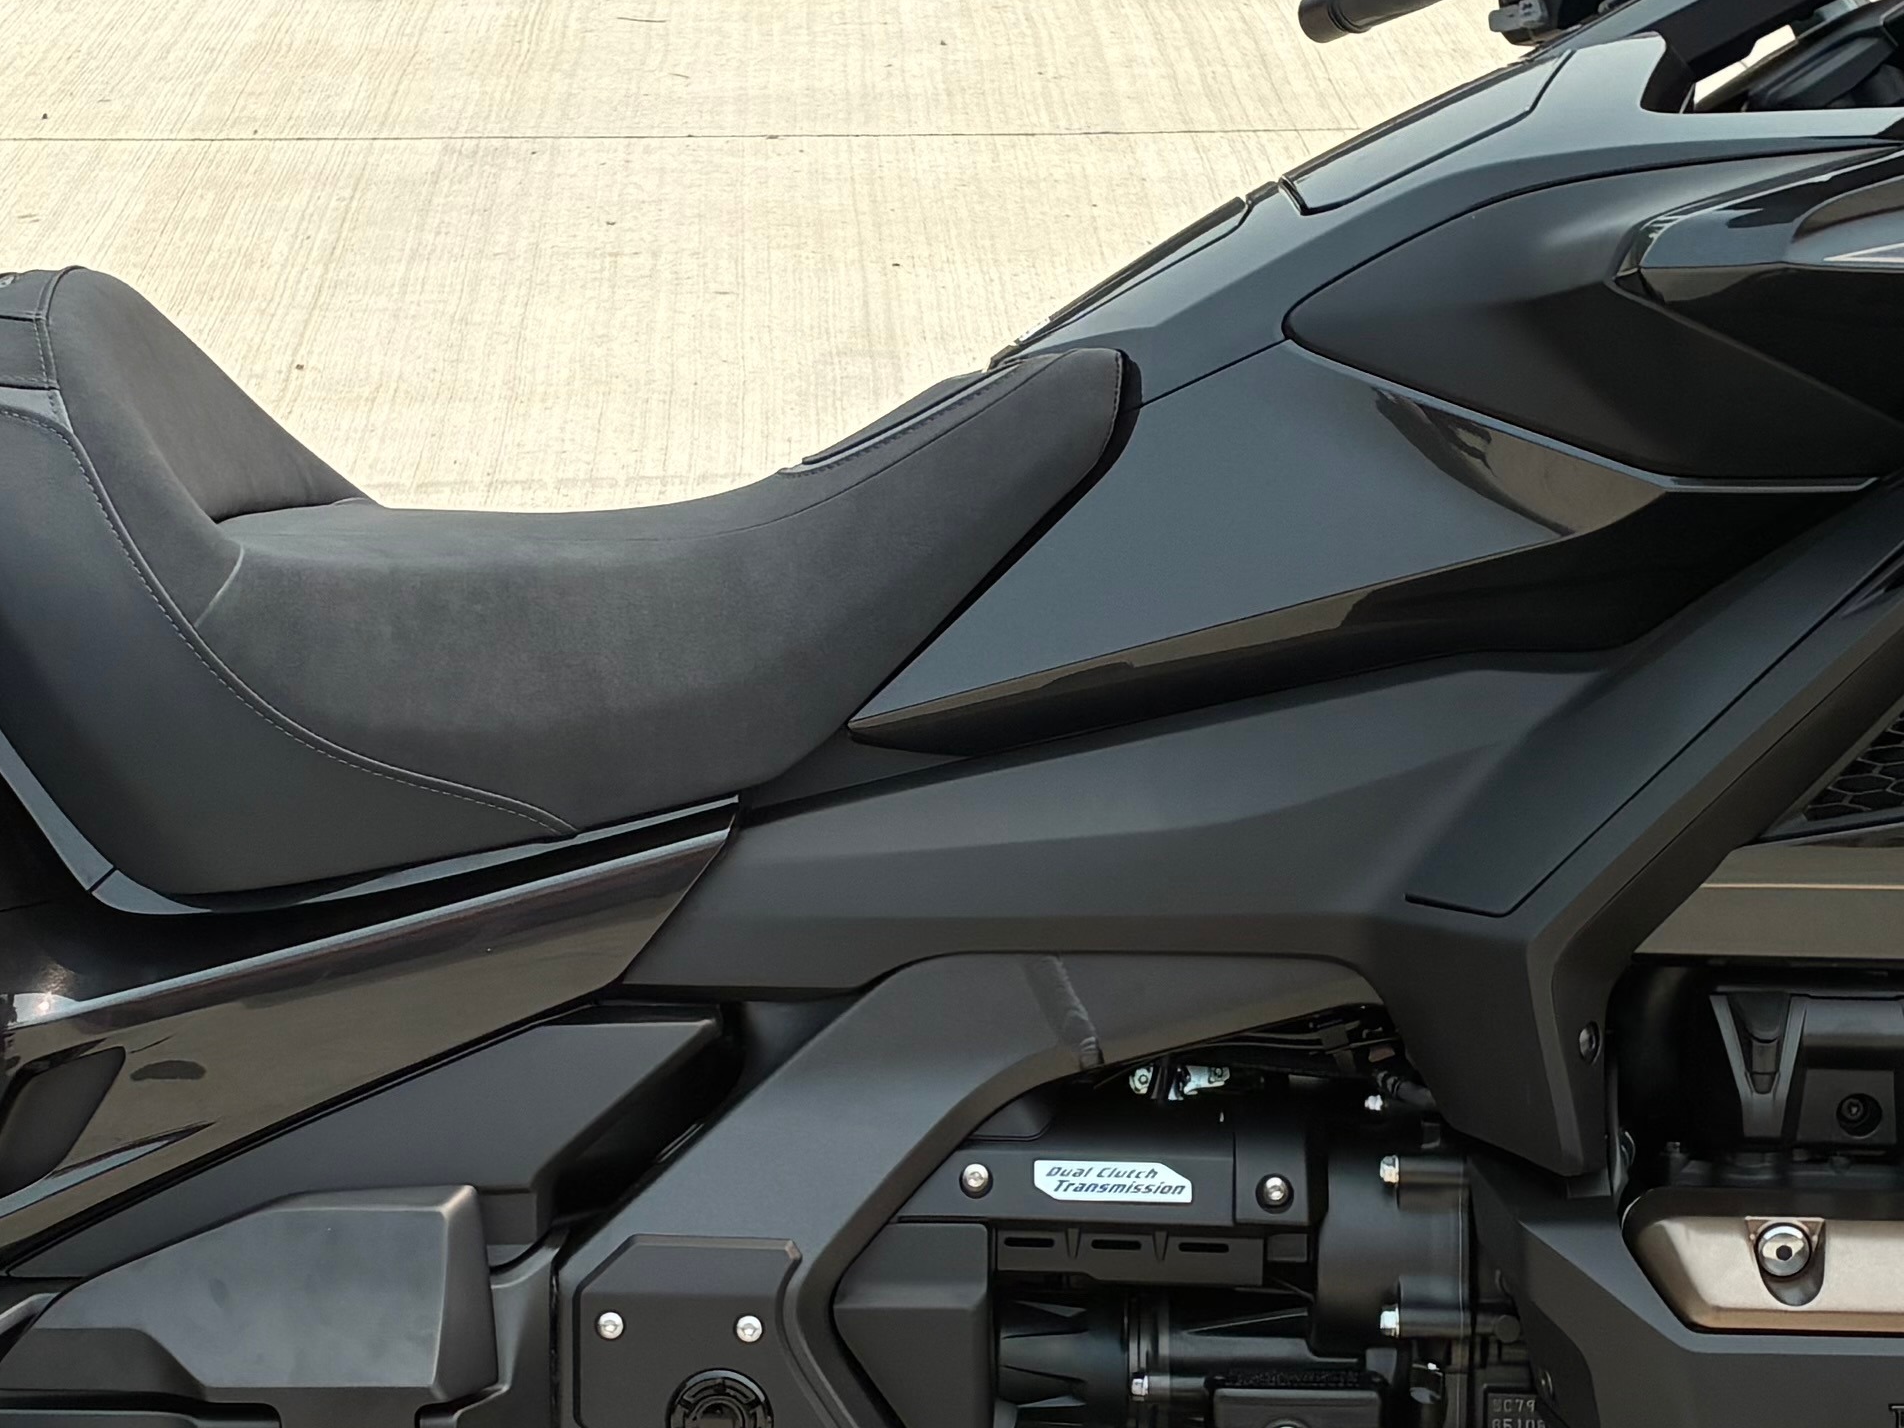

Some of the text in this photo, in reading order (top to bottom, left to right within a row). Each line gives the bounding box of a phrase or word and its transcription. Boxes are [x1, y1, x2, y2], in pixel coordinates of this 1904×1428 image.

[1046, 1166, 1159, 1179] Dual Clutch
[1053, 1179, 1187, 1195] Transmission
